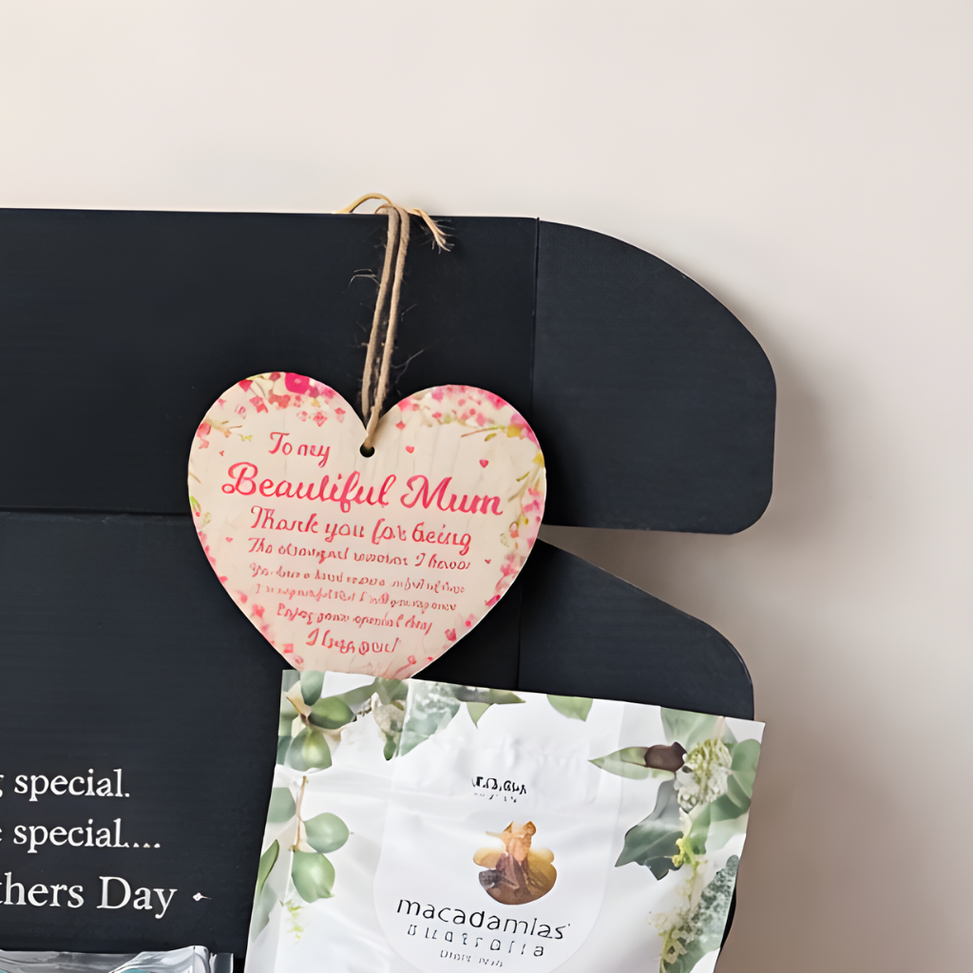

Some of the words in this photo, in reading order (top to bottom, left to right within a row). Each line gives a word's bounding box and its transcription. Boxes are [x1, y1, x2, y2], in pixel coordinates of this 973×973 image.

[221, 461, 397, 513] Beautiful
[400, 474, 505, 516] Mum
[324, 522, 366, 542] you
[12, 768, 131, 801] special.
[96, 875, 178, 919] Day
